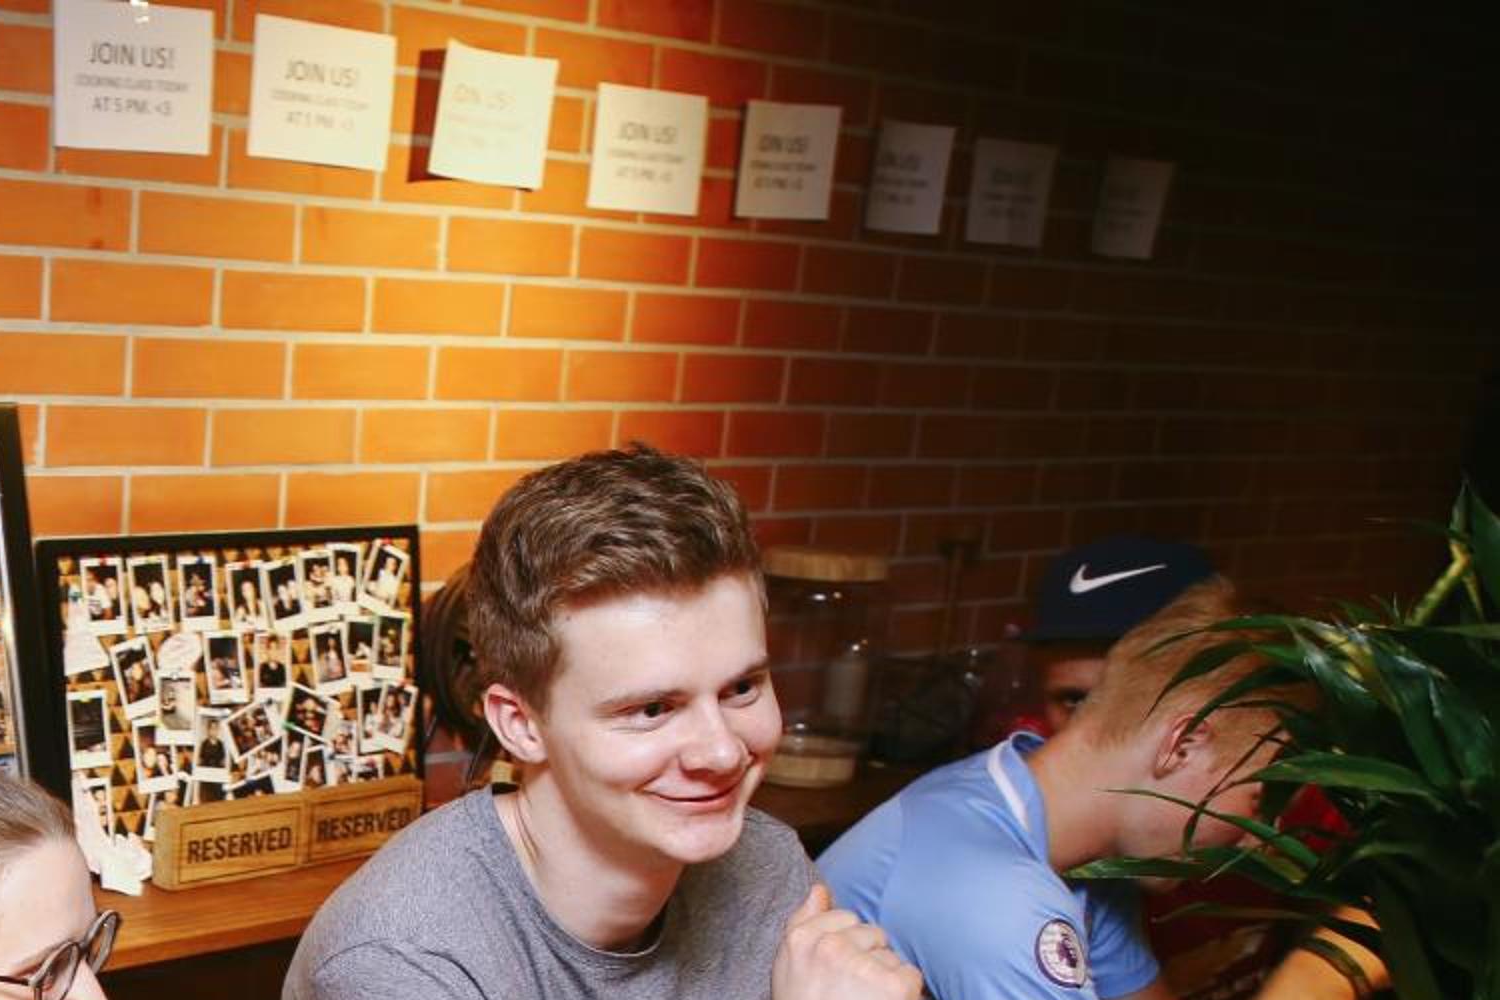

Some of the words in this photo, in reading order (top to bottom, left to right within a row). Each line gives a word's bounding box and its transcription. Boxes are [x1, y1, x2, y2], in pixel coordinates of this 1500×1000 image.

[88, 41, 135, 65] JOIN
[141, 47, 175, 69] US!
[284, 60, 325, 83] JOIN
[316, 807, 412, 842] RESERVED
[187, 827, 292, 864] RESERVED
